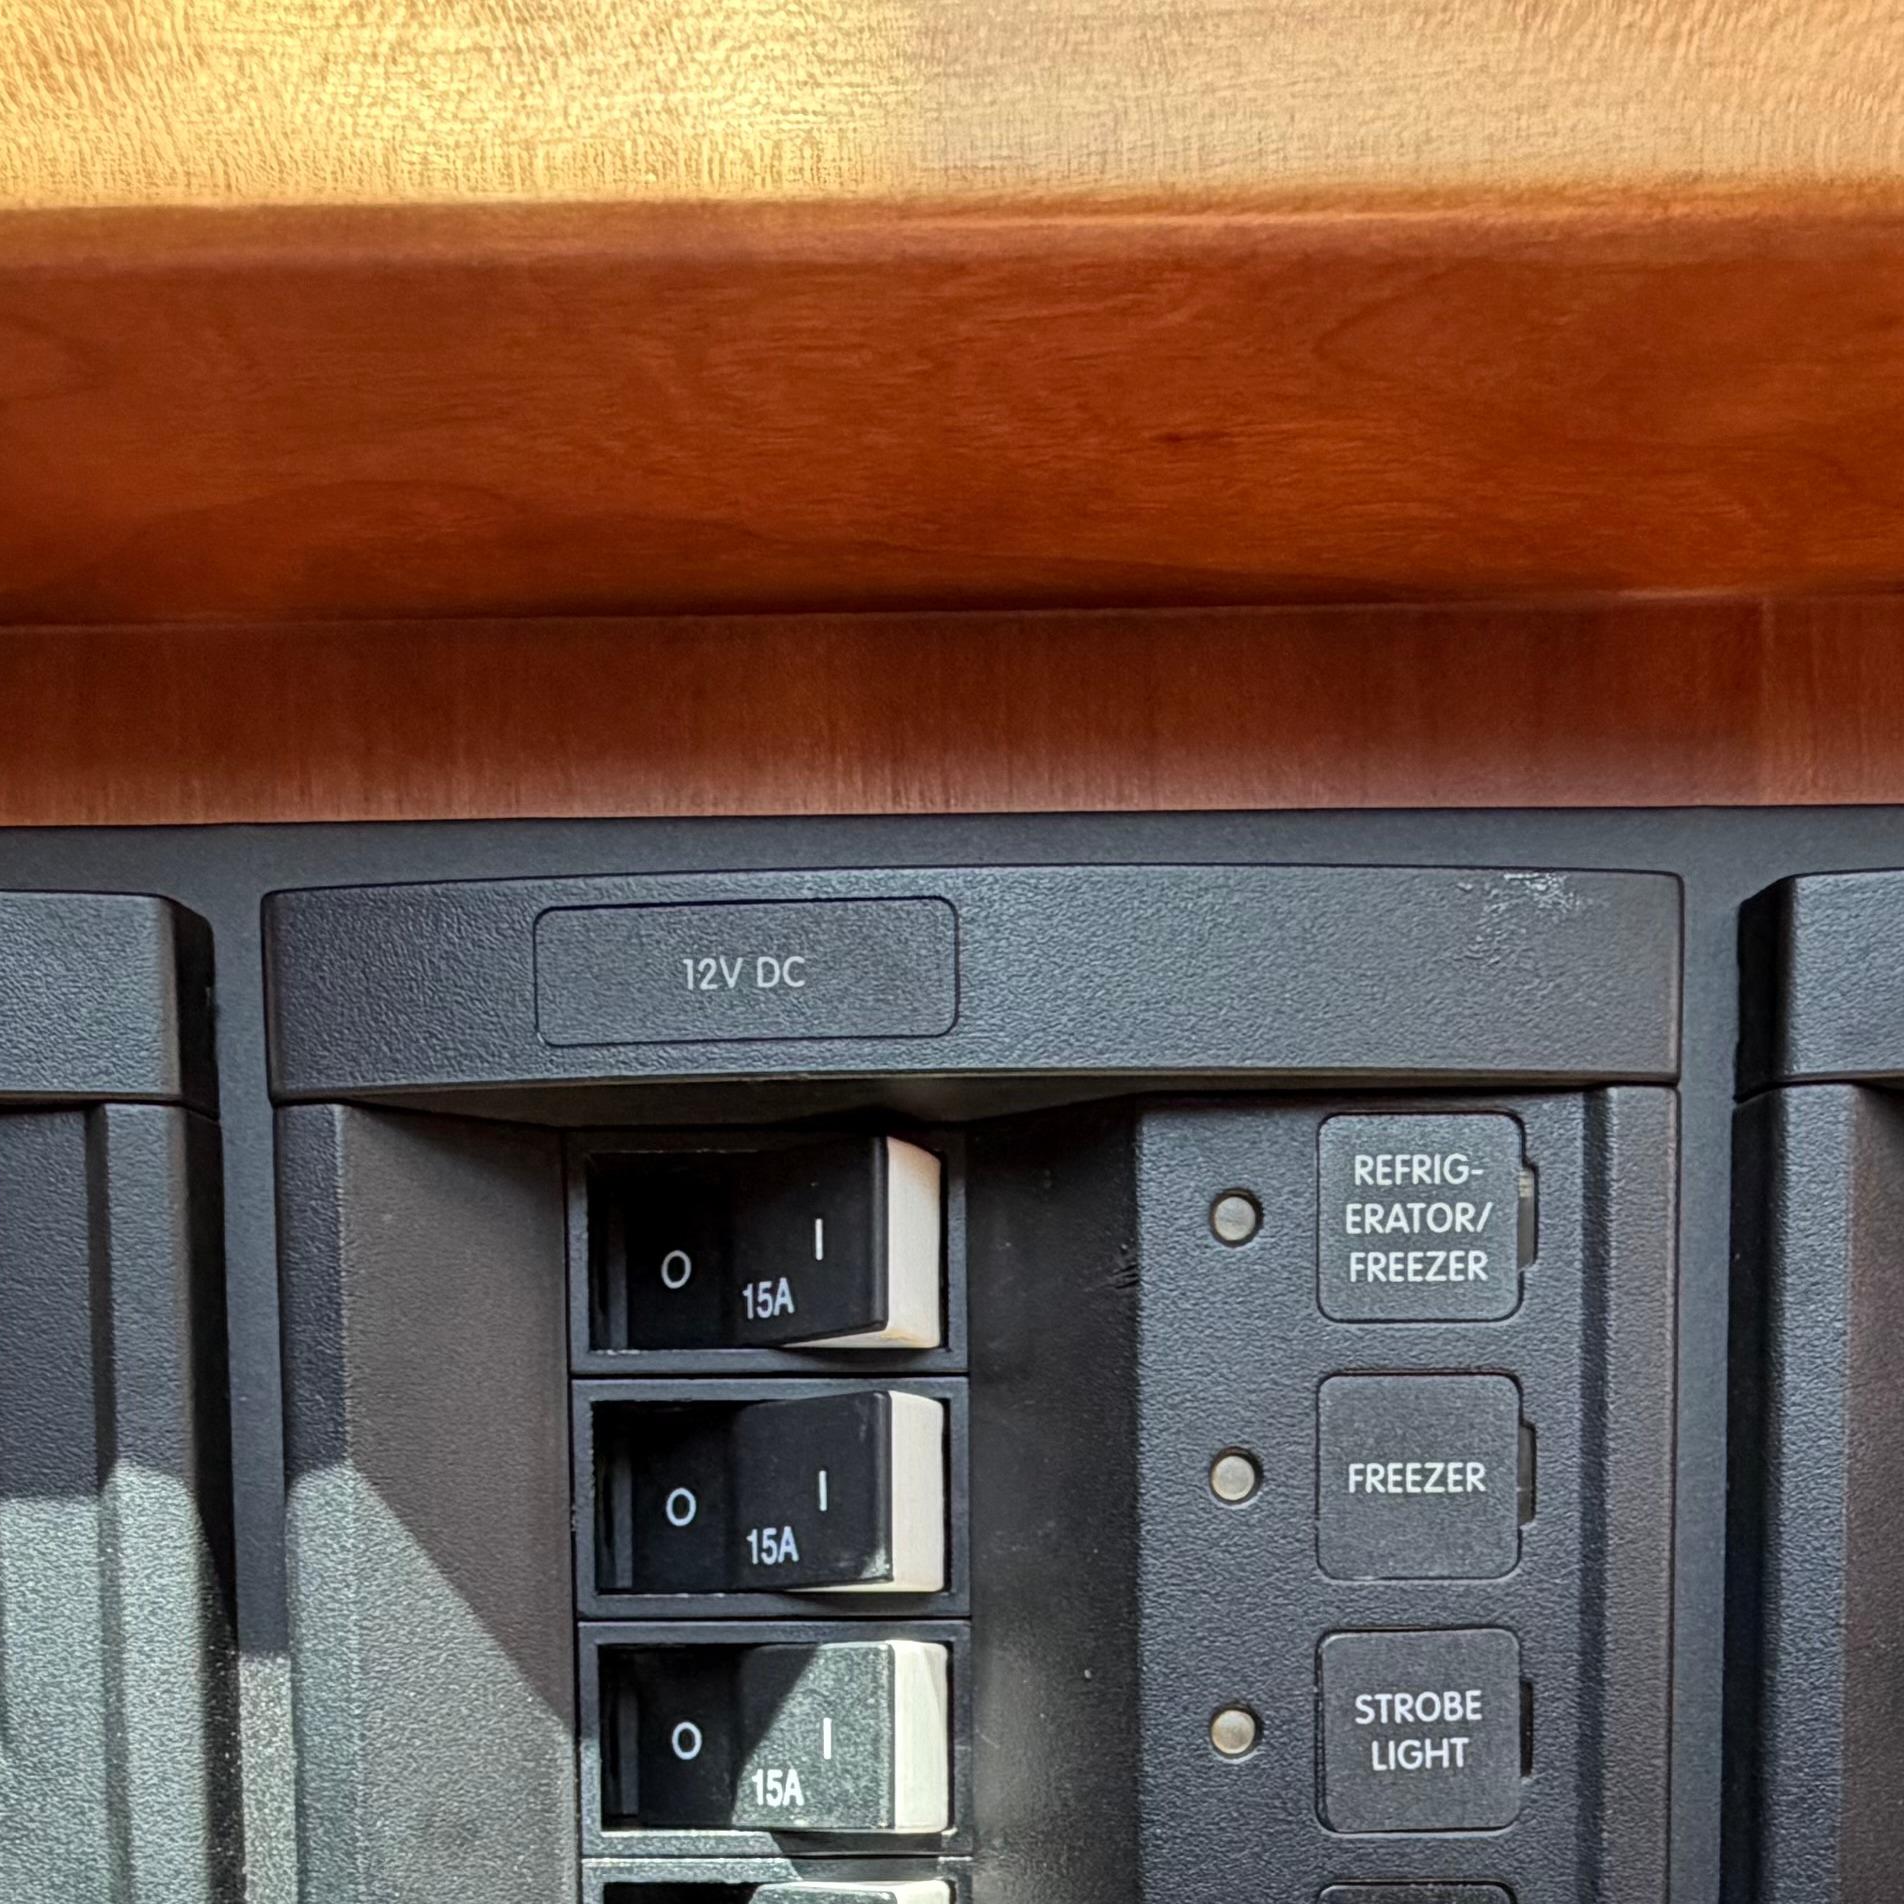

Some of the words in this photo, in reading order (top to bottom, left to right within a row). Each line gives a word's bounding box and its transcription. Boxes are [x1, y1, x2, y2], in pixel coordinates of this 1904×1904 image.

[682, 955, 744, 991] 12V
[756, 955, 806, 989] DC
[1354, 1152, 1485, 1186] REFRIG-
[1345, 1201, 1494, 1235] ERATOR/
[1349, 1249, 1489, 1283] FREEZER
[742, 1277, 795, 1319] 15A
[1348, 1461, 1487, 1494] FREEZER
[746, 1525, 799, 1565] 15A
[1355, 1689, 1483, 1725] STROBE
[1371, 1737, 1470, 1771] LIGHT
[751, 1765, 805, 1808] 15A
